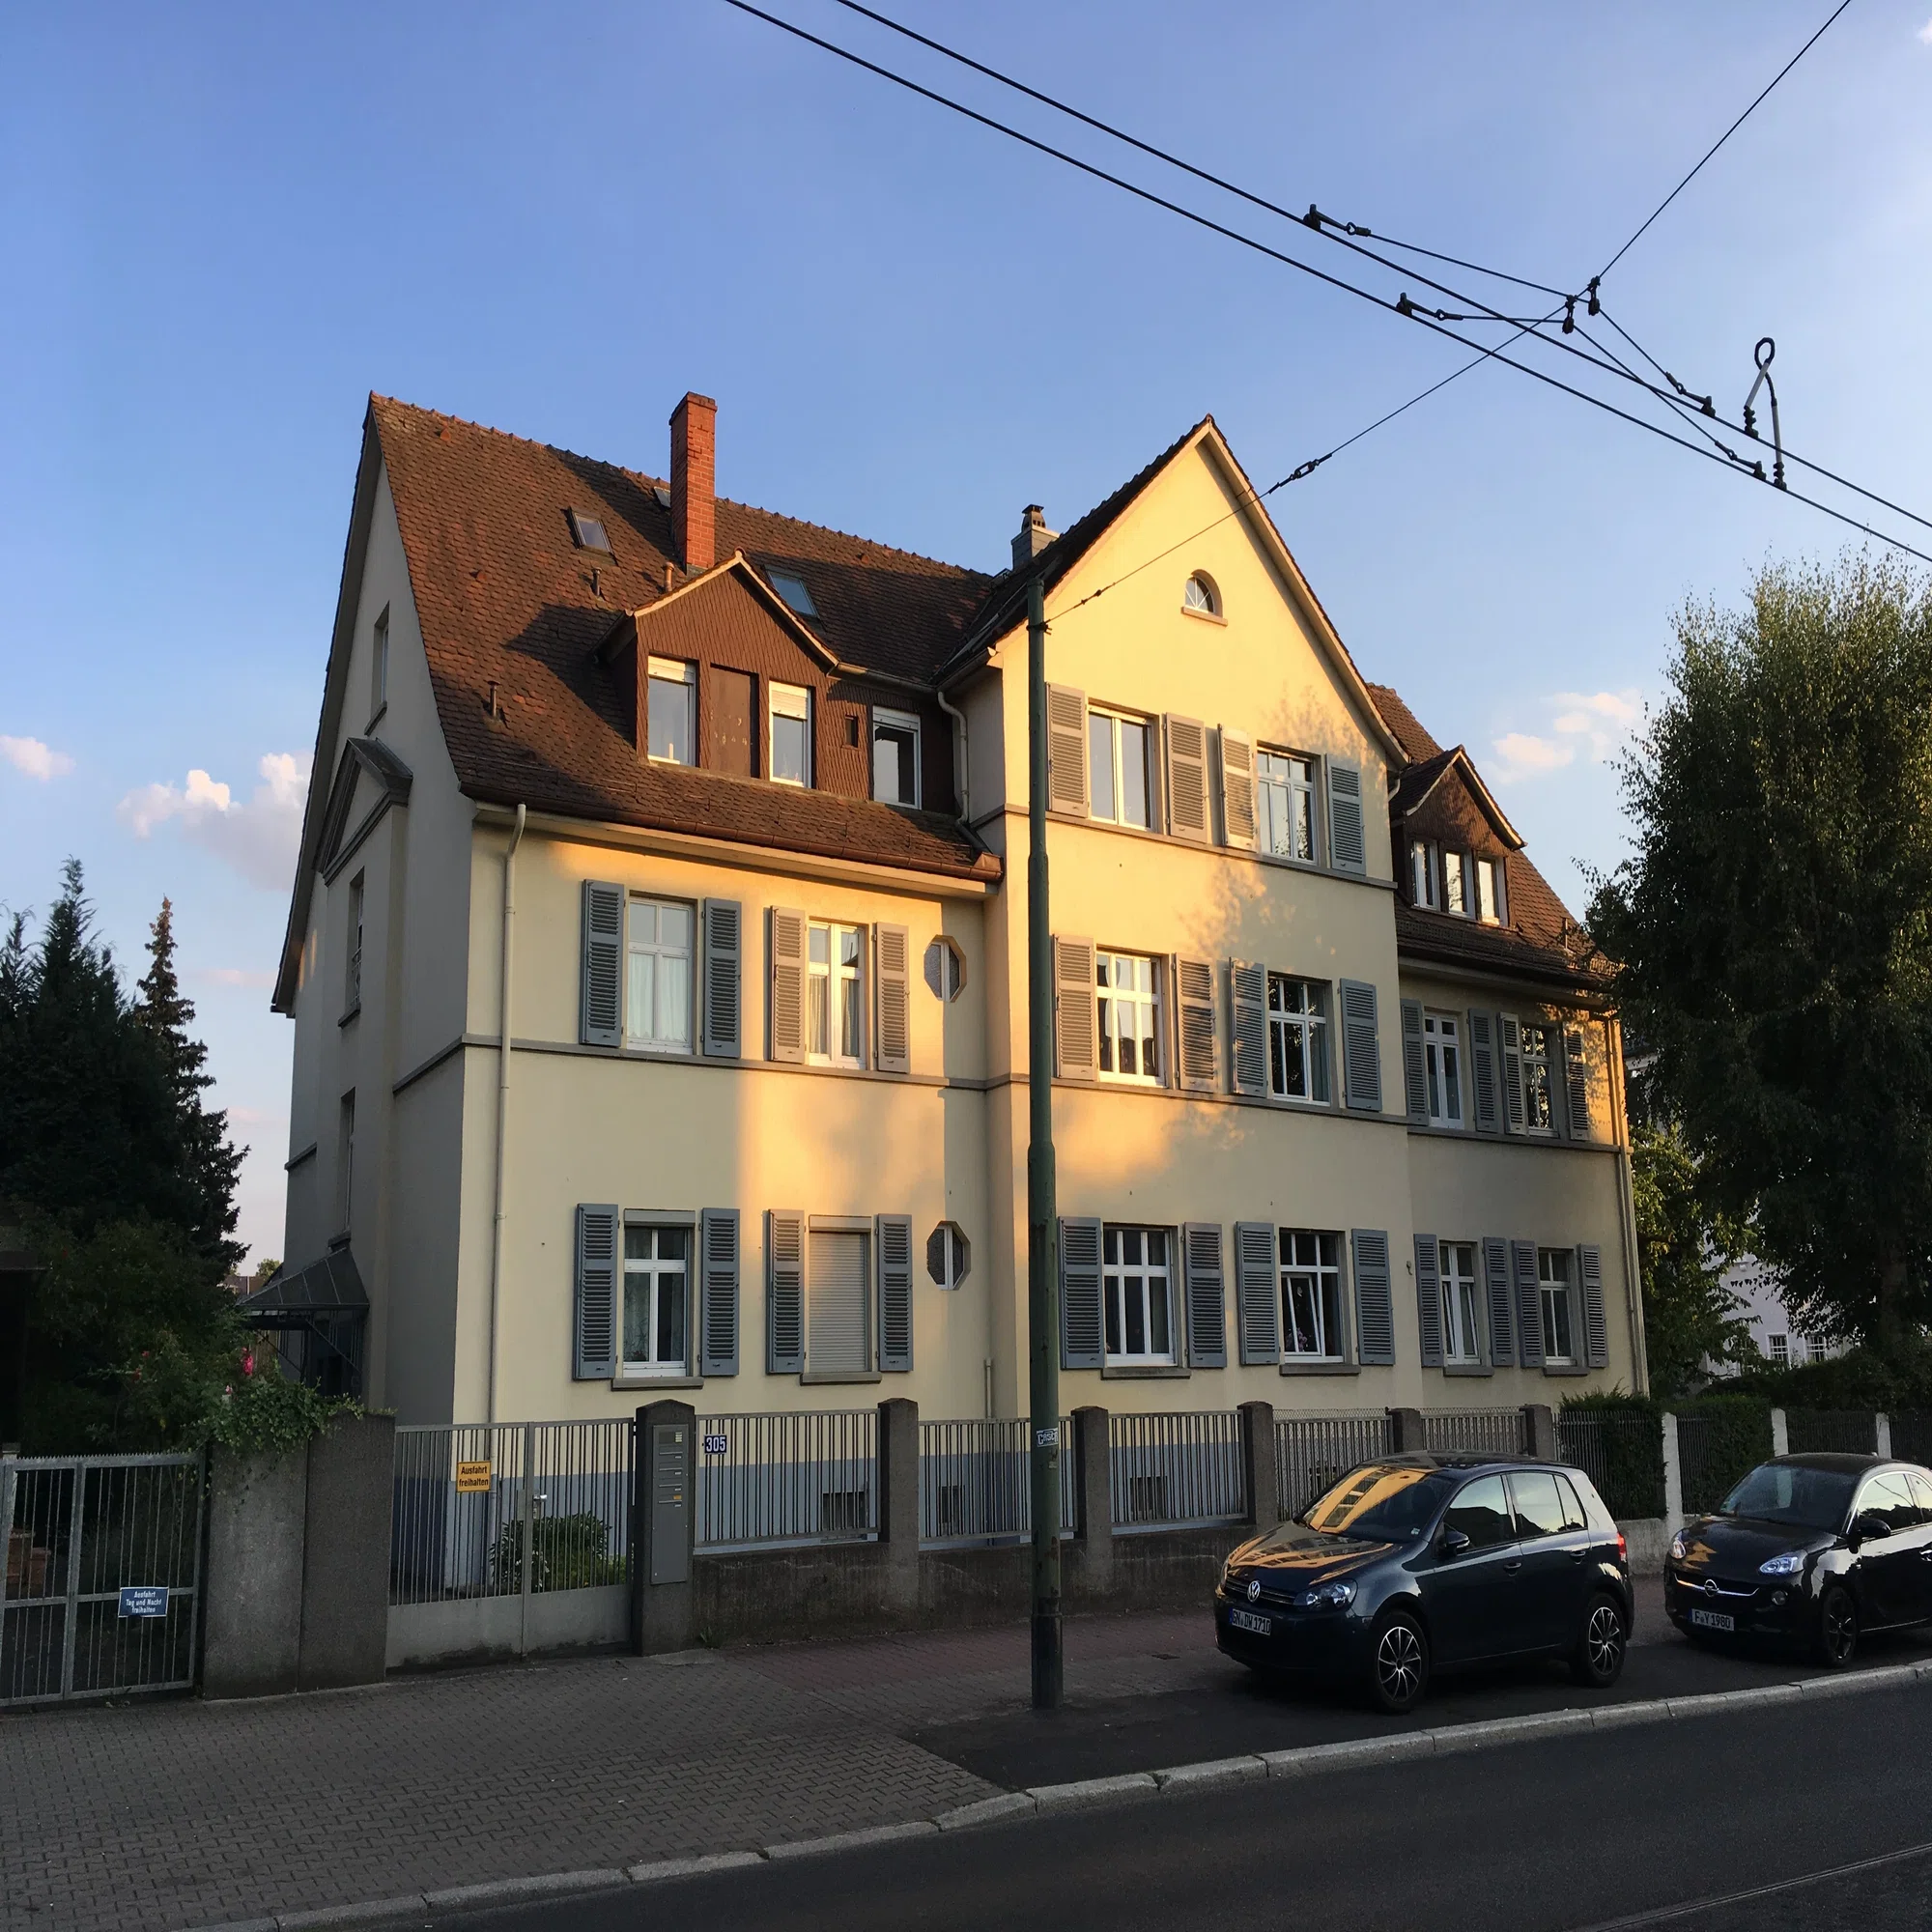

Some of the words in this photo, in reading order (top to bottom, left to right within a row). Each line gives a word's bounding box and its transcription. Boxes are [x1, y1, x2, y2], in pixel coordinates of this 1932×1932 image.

[706, 1436, 726, 1452] 305
[461, 1465, 488, 1475] Ausfahrt
[459, 1478, 489, 1487] freihalten
[133, 1590, 156, 1599] Ausfahrt
